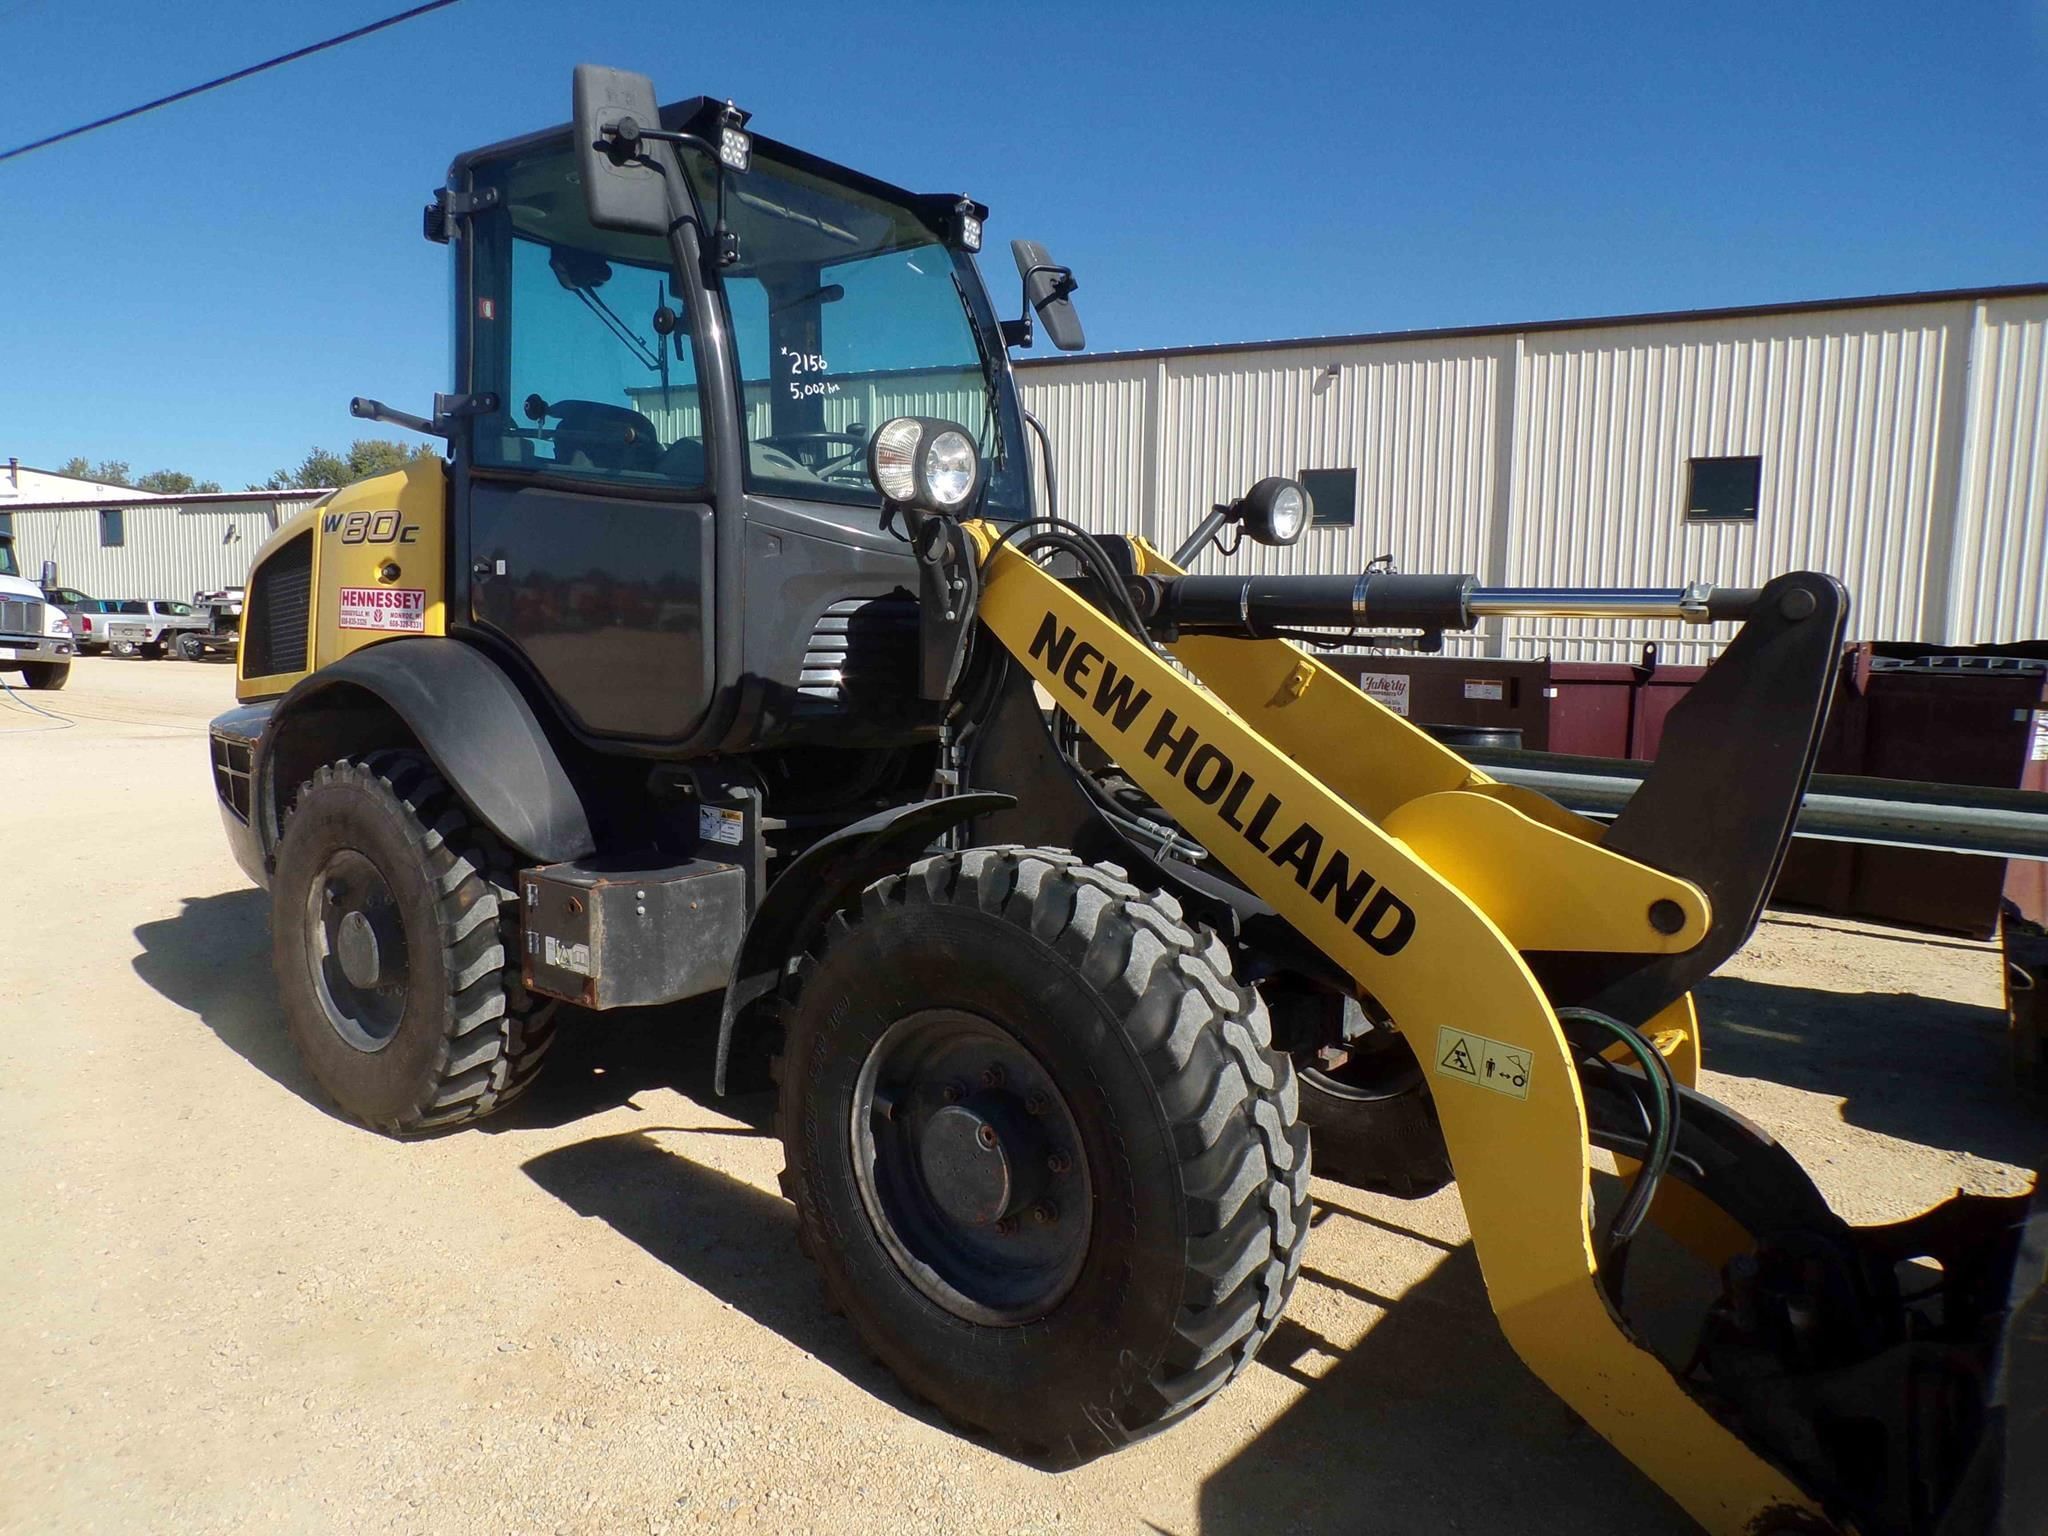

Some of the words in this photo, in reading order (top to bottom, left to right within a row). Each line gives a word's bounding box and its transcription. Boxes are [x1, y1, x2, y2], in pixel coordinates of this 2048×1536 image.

[790, 382, 825, 400] 5,002
[342, 591, 422, 609] HENNESSEY
[1028, 611, 1152, 733] NEW
[1143, 709, 1416, 957] HOLLAND
